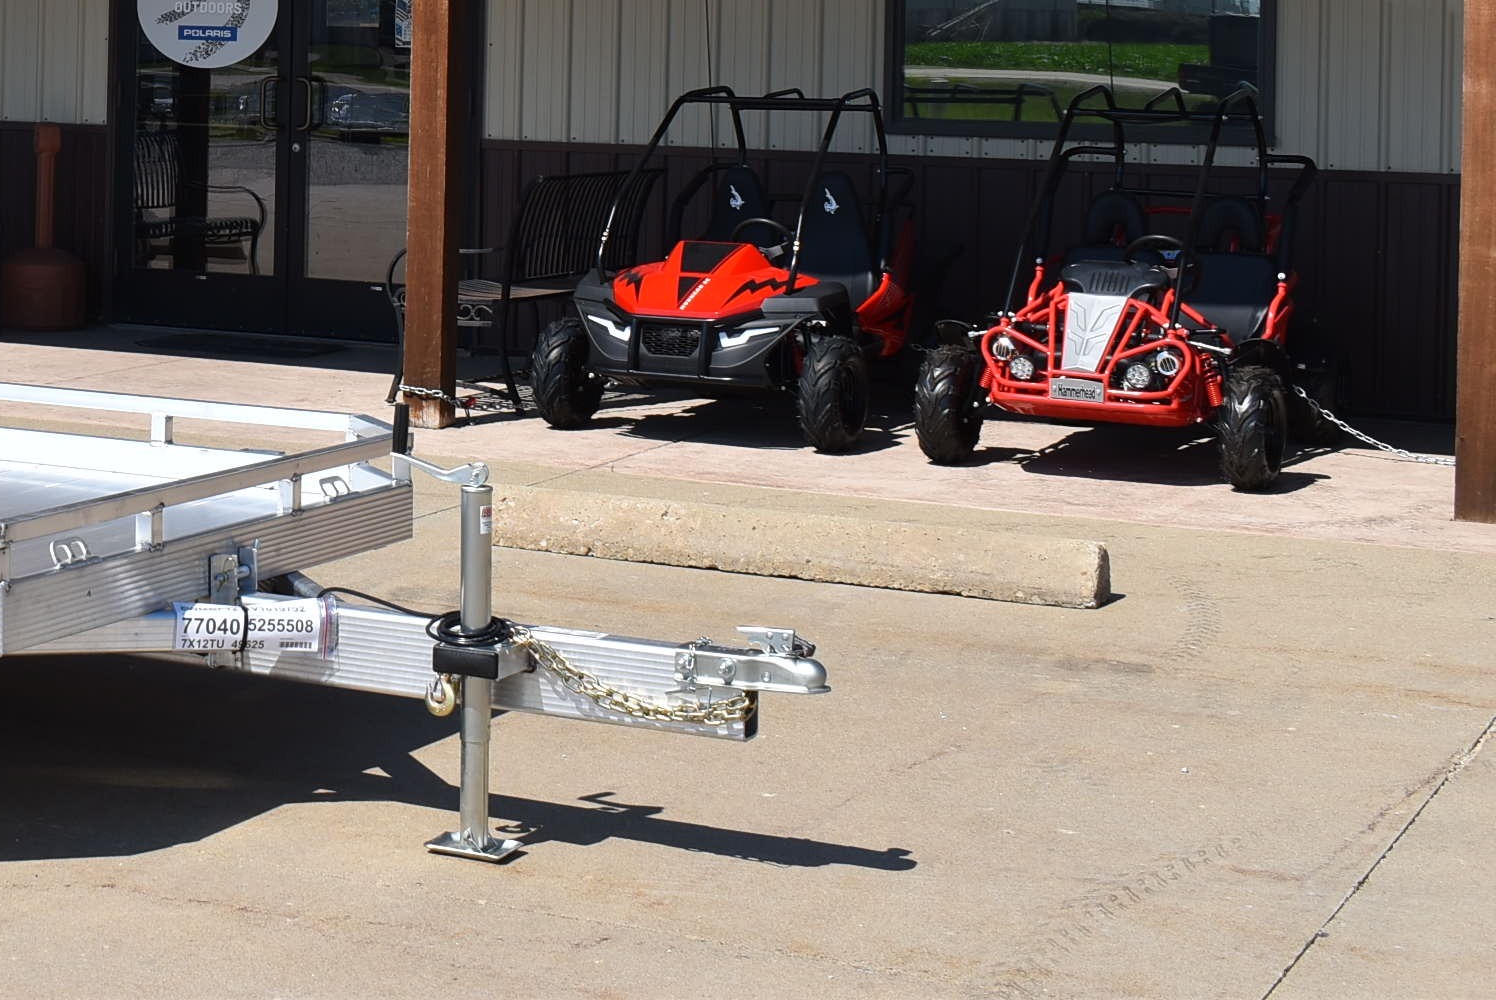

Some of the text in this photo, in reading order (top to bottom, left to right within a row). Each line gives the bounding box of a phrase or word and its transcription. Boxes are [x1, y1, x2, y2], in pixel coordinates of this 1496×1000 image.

[175, 1, 242, 14] OUTDOORS
[184, 29, 231, 38] POLARIS
[1058, 383, 1096, 399] Hammerhead
[182, 617, 314, 635] 77040 5255508
[181, 638, 225, 649] 7X12TU
